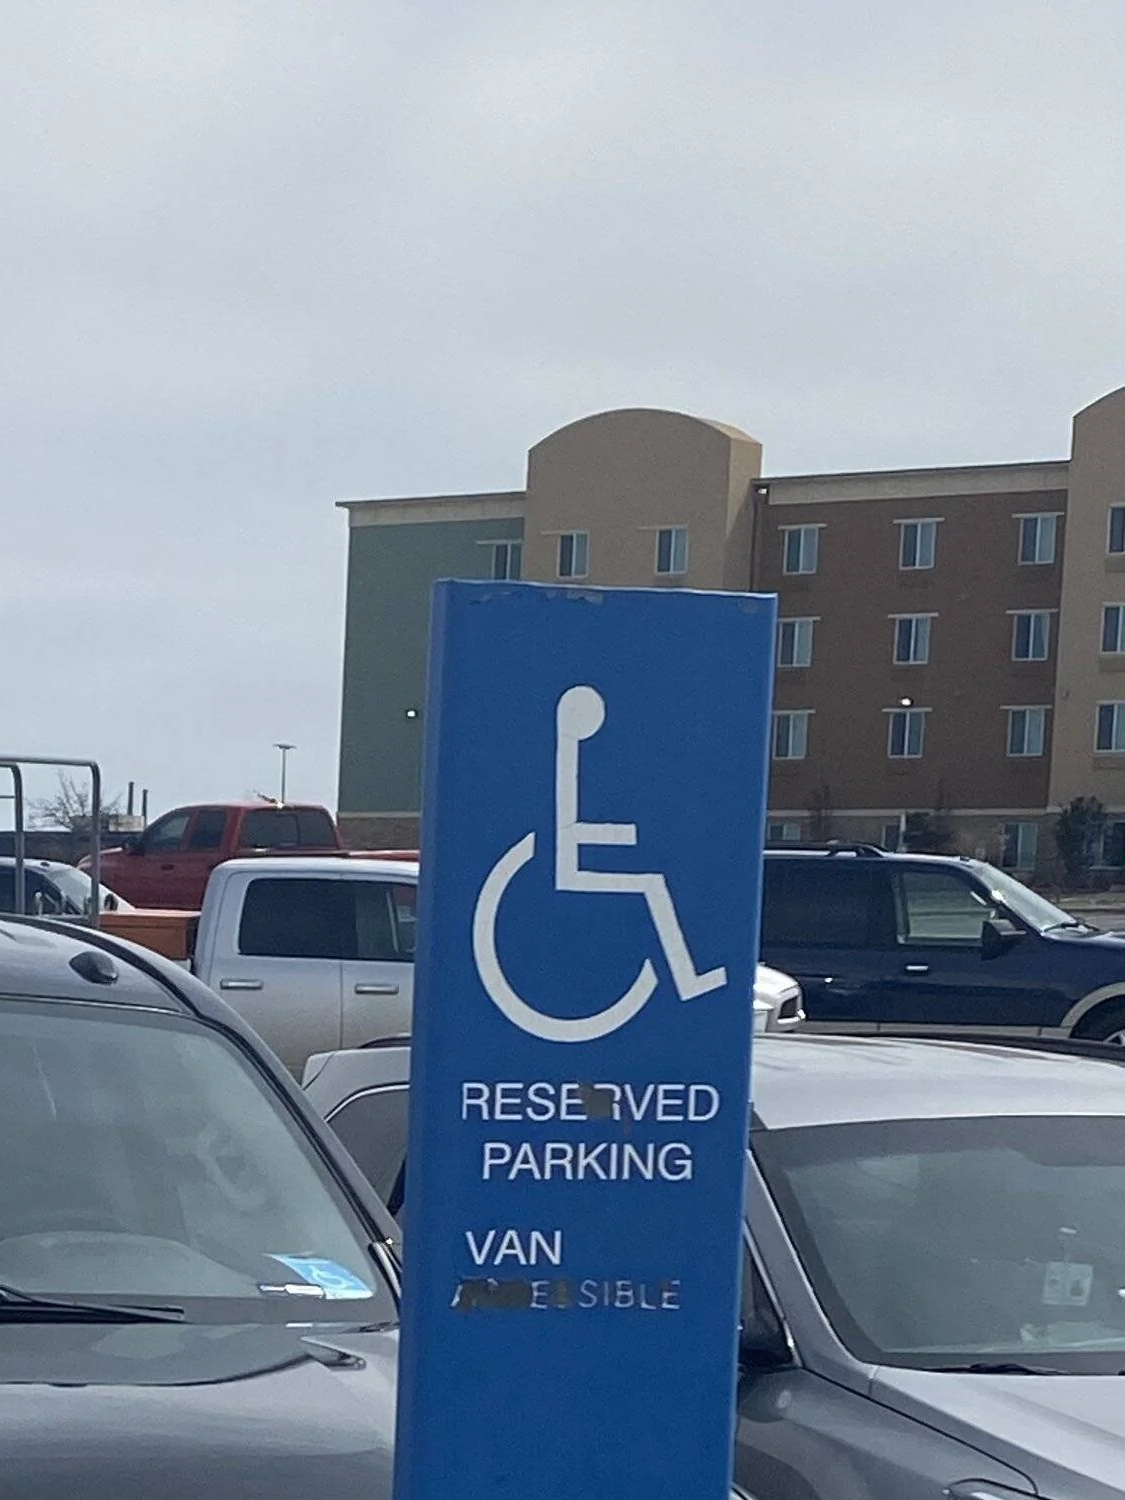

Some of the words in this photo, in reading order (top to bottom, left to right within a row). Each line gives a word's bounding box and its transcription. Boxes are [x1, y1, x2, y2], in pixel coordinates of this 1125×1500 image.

[481, 1142, 693, 1181] PARKING
[465, 1229, 563, 1266] VAN
[450, 1279, 682, 1311] ESIBLE
